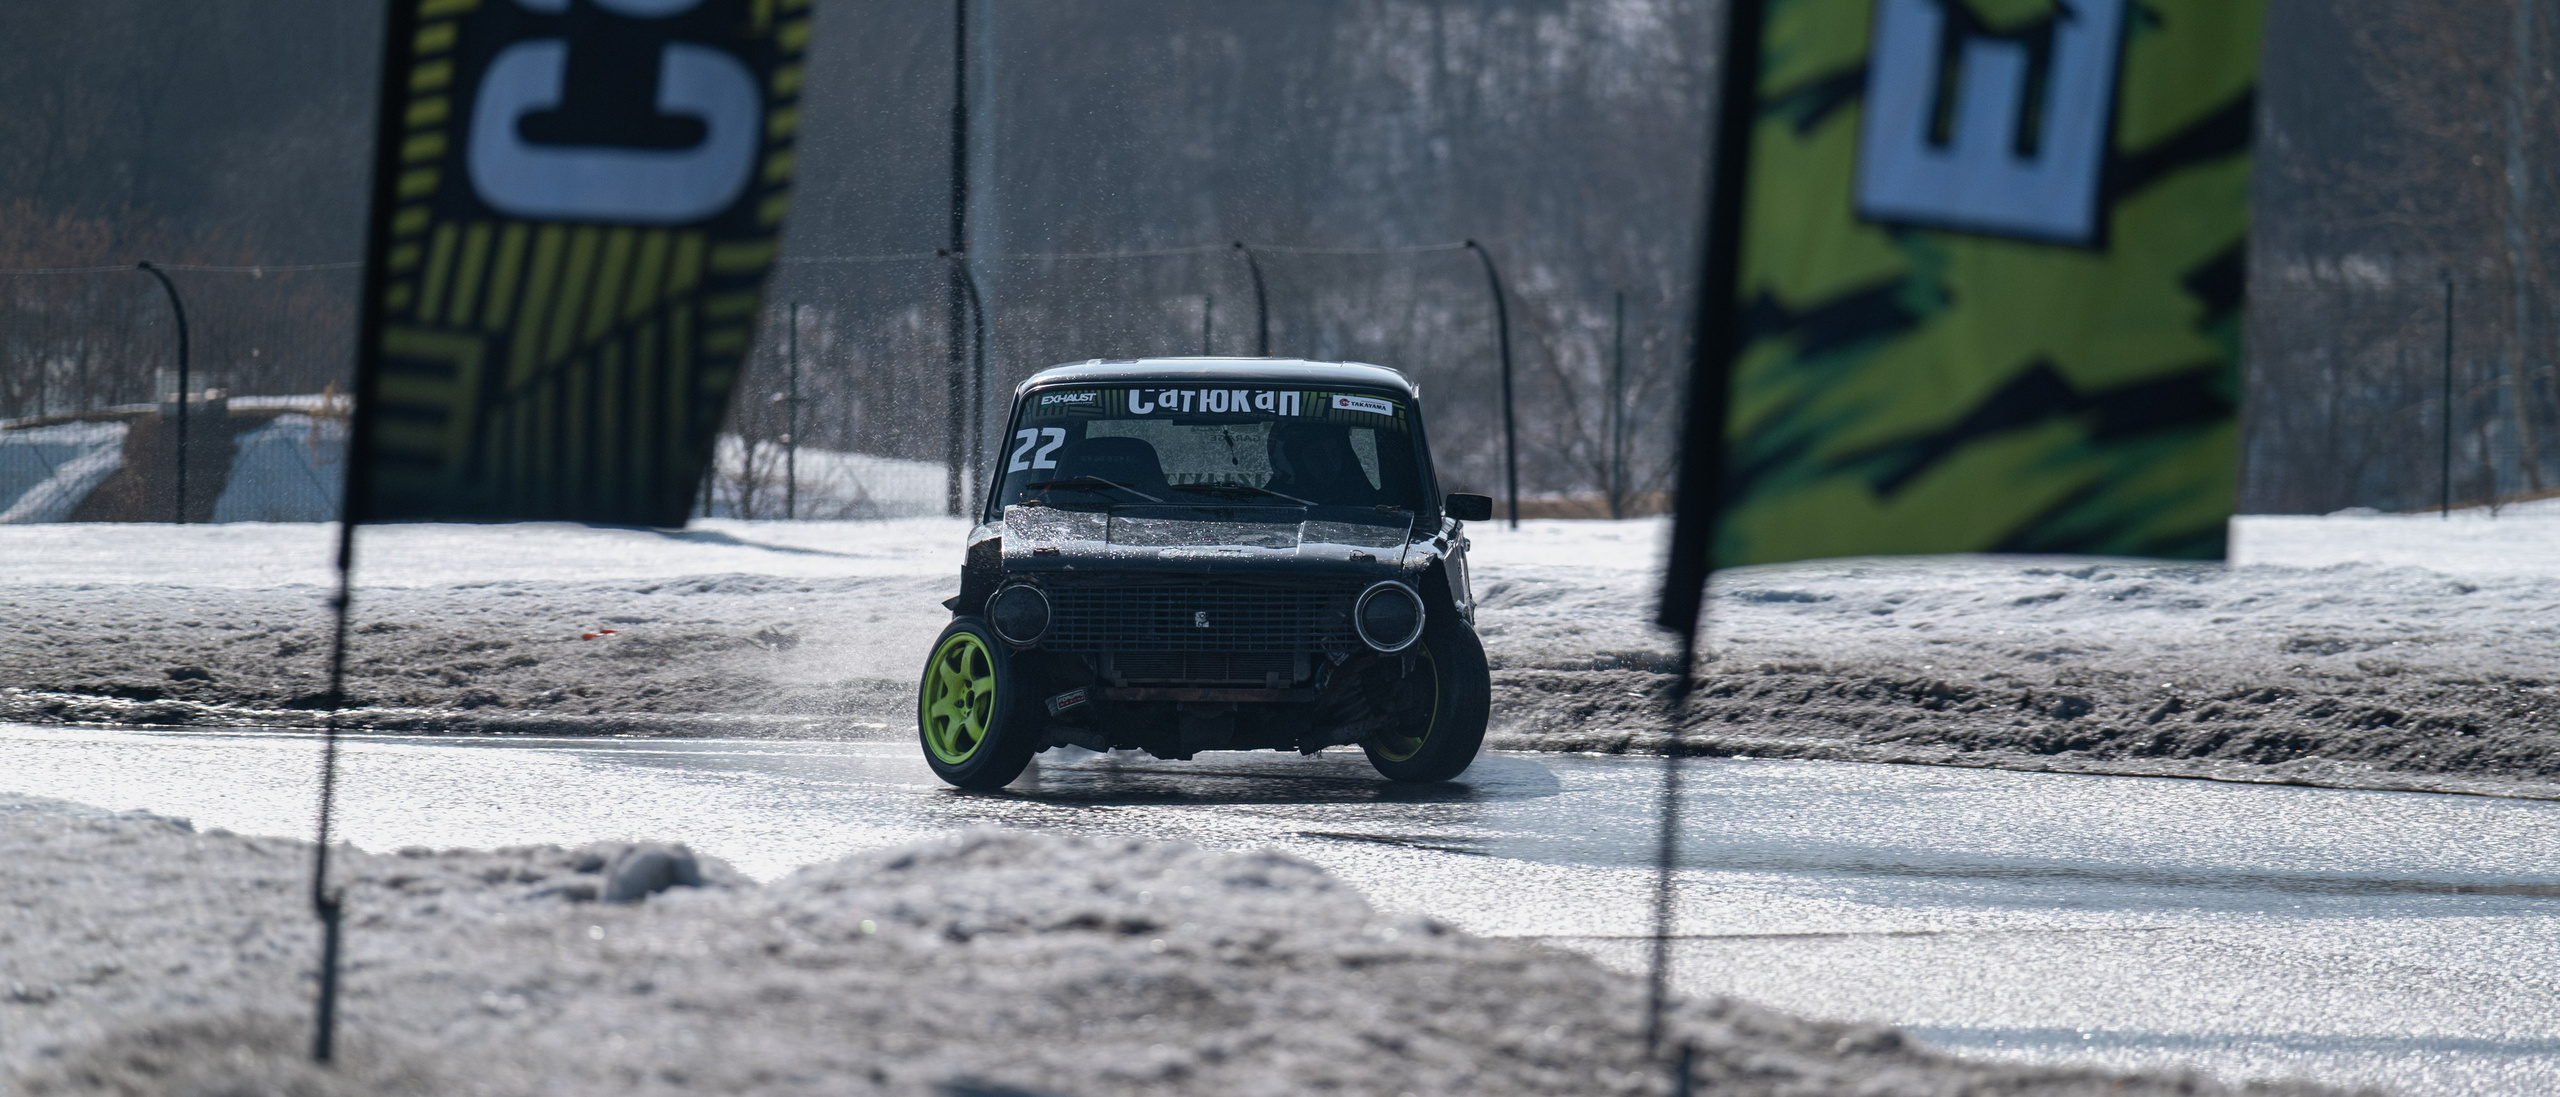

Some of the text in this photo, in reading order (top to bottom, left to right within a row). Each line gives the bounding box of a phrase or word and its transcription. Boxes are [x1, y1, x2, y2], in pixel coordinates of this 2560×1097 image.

[1041, 392, 1097, 405] EXHAUST
[1350, 401, 1387, 411] TAKAYAMA
[1007, 427, 1066, 474] 22
